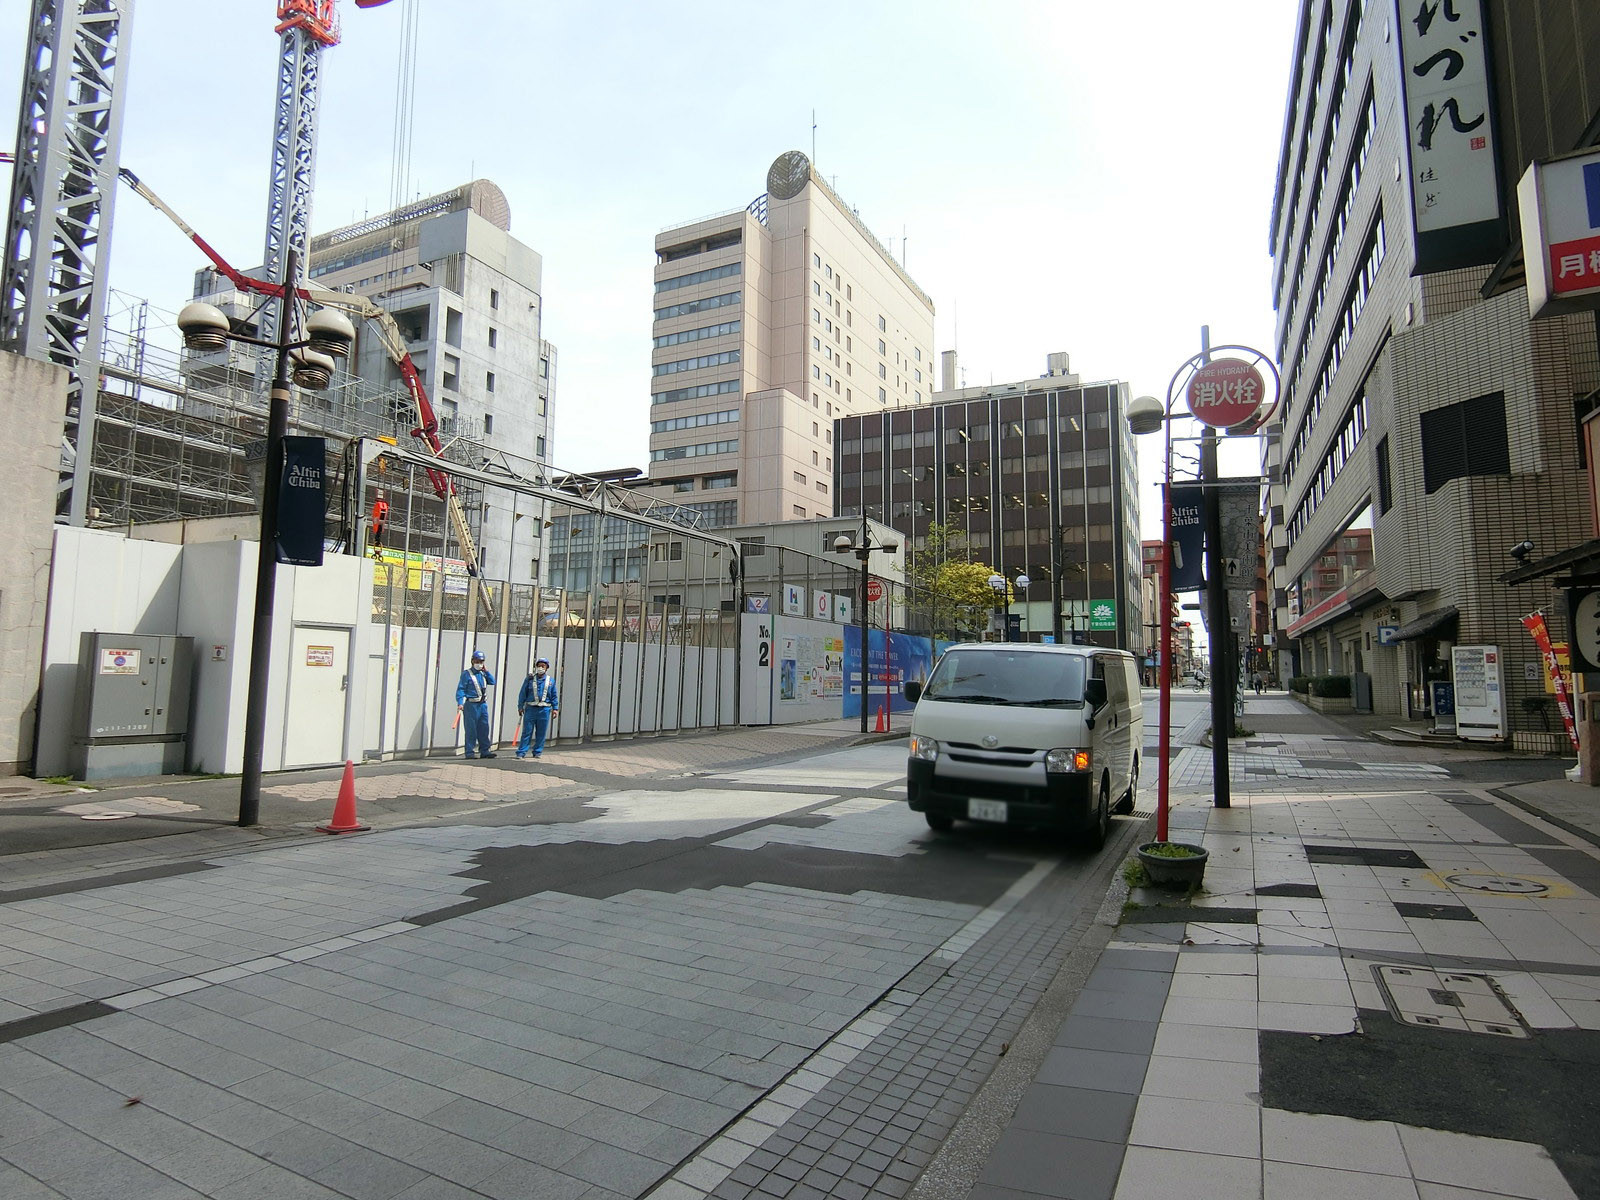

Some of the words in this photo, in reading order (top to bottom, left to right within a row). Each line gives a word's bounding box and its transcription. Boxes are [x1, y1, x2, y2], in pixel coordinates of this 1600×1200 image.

[1199, 369, 1215, 378] FIRE
[1217, 366, 1250, 377] HYDRANT
[1193, 377, 1258, 408] 消火栓
[291, 464, 320, 479] Altiri
[288, 475, 321, 489] Chiba
[755, 599, 762, 608] 2
[759, 625, 770, 639] No.
[1380, 628, 1396, 643] P
[758, 641, 769, 667] 2
[884, 651, 899, 661] TWER
